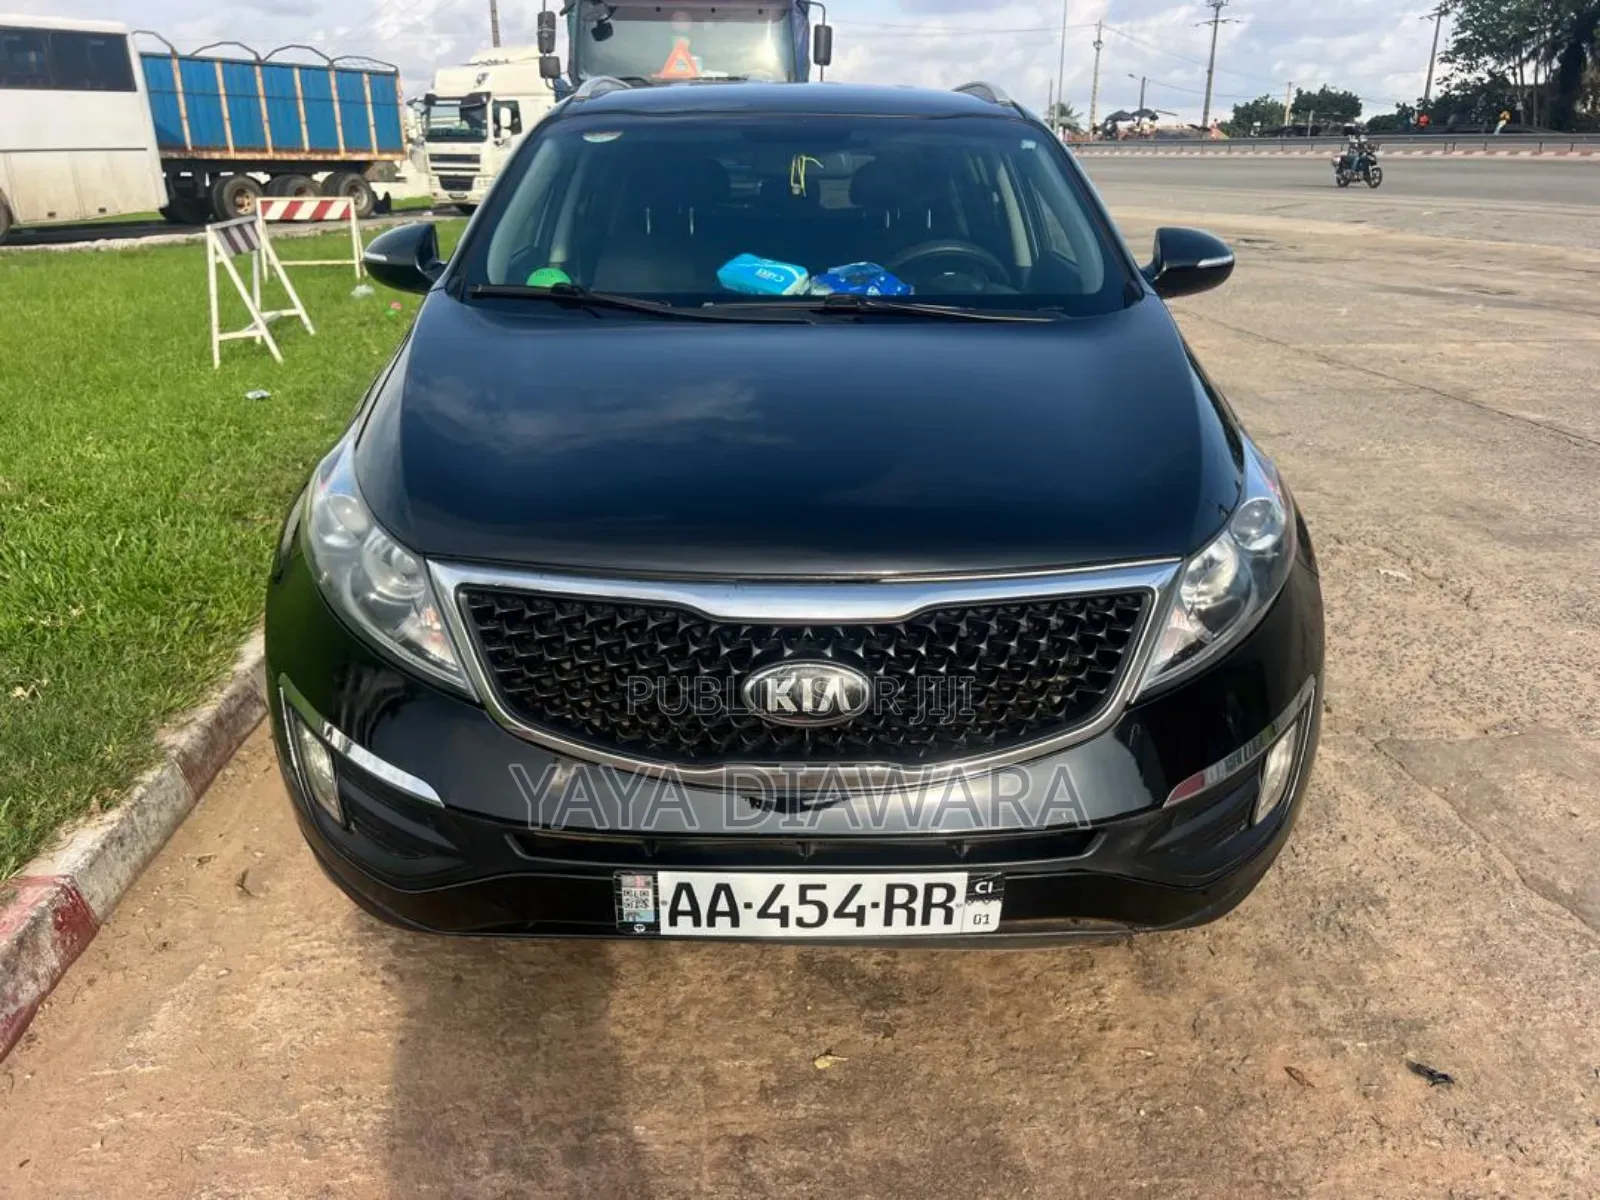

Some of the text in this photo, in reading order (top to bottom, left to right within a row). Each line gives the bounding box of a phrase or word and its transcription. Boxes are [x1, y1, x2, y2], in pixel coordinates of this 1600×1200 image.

[765, 672, 851, 712] KIA
[974, 881, 993, 894] CI
[668, 882, 956, 929] AA-454-RR
[973, 913, 990, 925] 01
